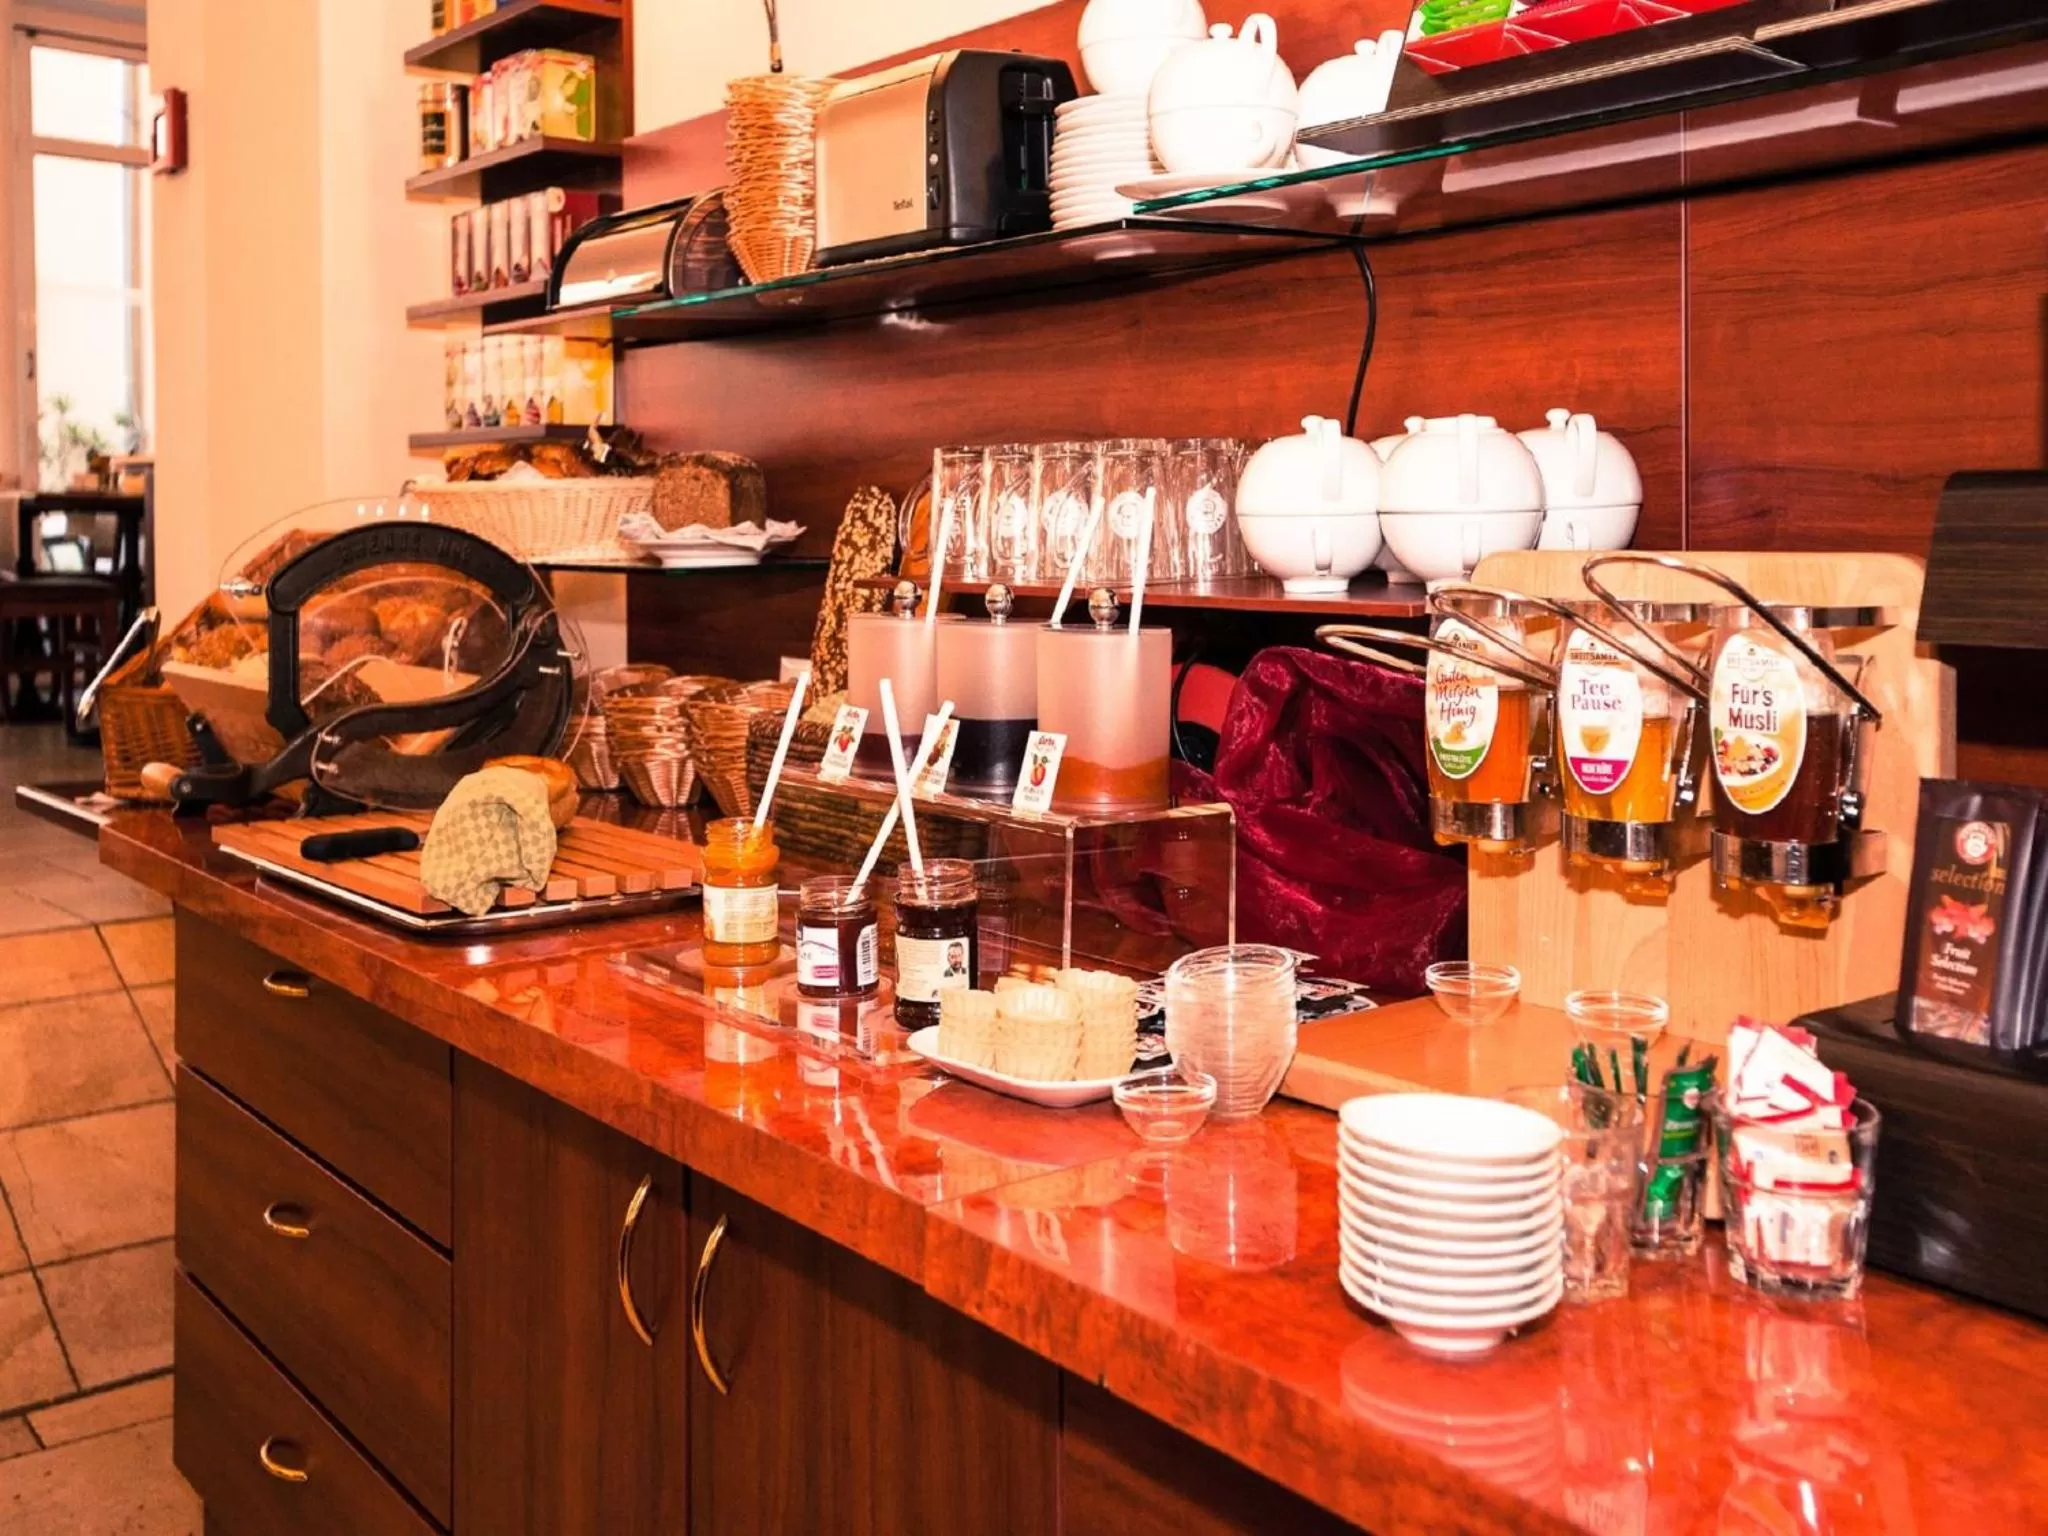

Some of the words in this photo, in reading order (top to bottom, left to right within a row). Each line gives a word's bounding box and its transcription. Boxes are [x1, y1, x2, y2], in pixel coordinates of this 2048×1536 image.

[883, 197, 913, 210] Tefal
[1436, 664, 1470, 684] Guten
[1433, 684, 1482, 706] Morgen
[1579, 679, 1610, 696] Tee
[1572, 694, 1622, 710] Pause
[1440, 702, 1477, 728] Honig
[1728, 707, 1777, 732] Müsli
[1930, 864, 2005, 896] selection
[1943, 942, 1971, 960] Fruit
[1931, 953, 1978, 977] Selection
